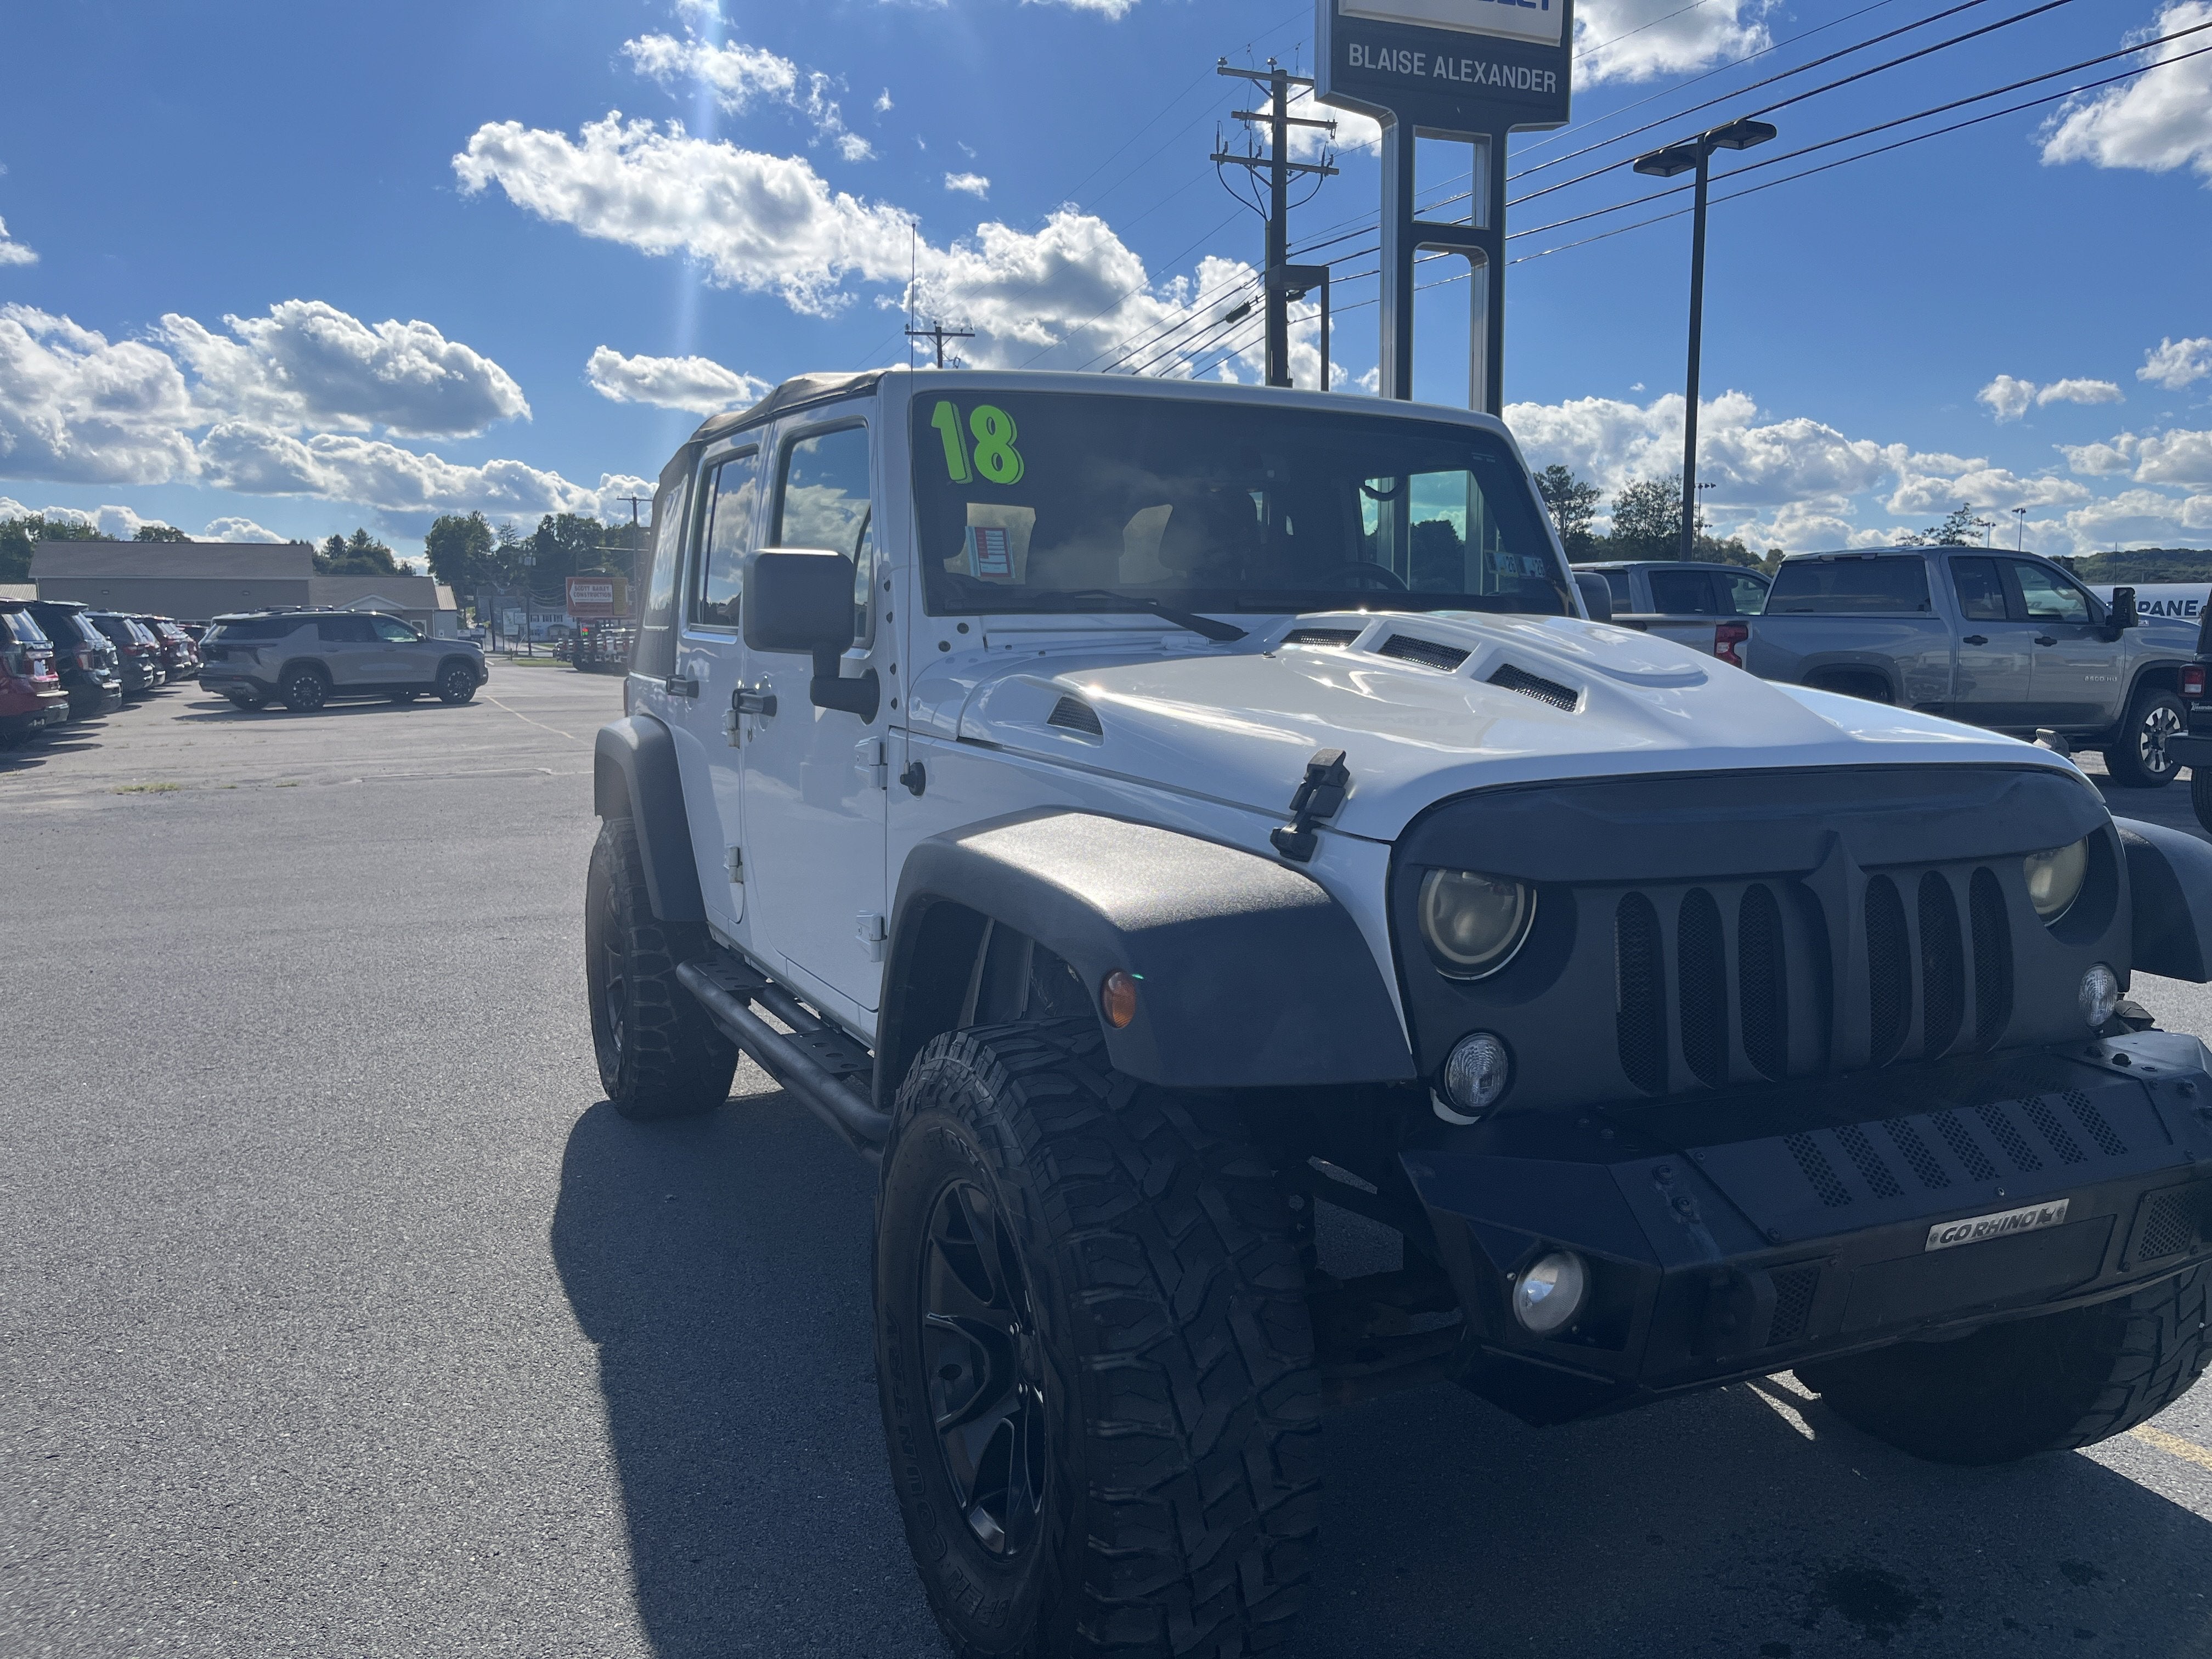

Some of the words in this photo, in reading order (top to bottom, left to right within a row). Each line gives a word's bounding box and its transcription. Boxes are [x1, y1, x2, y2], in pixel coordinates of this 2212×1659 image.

[1348, 43, 1426, 76] BLAISE
[1433, 56, 1556, 93] ALEXANDER
[931, 401, 1024, 485] 18
